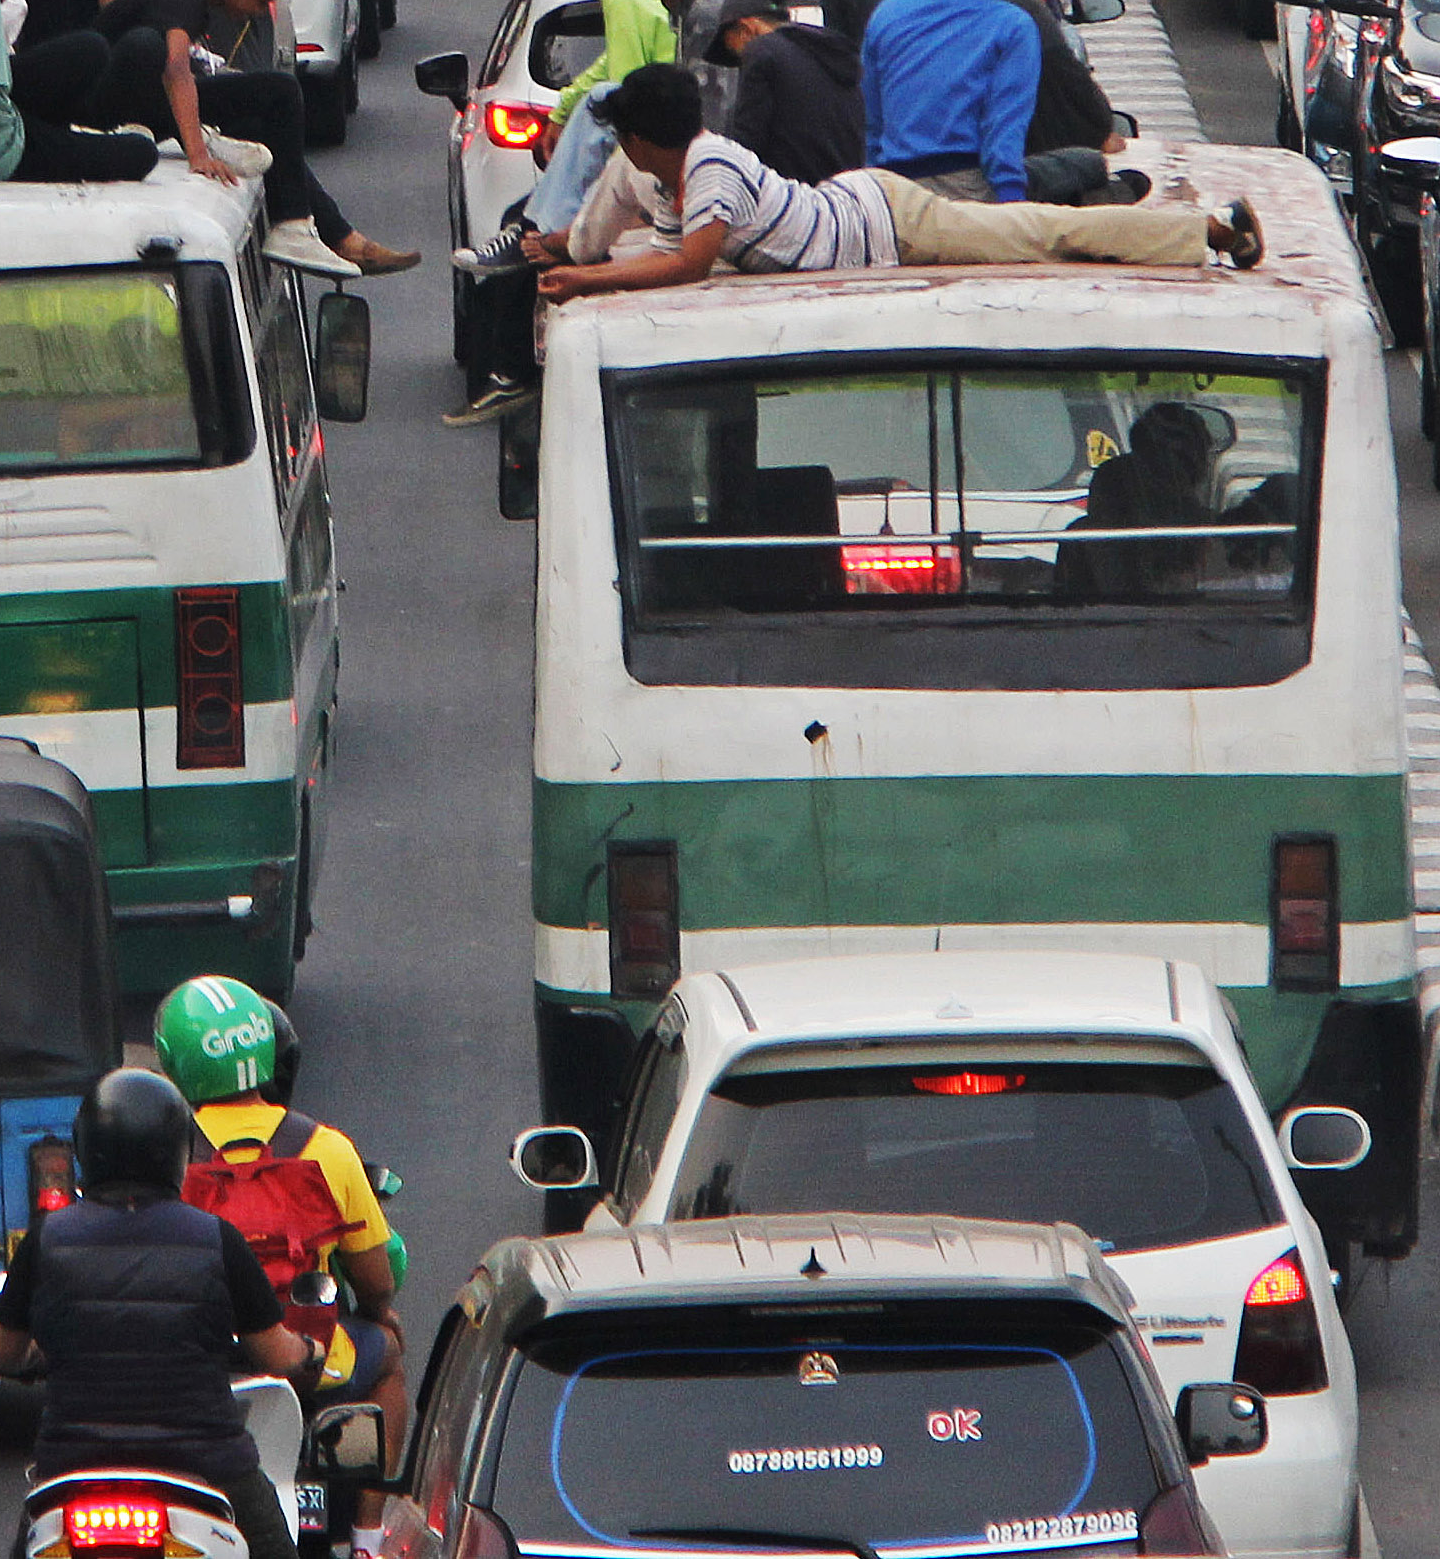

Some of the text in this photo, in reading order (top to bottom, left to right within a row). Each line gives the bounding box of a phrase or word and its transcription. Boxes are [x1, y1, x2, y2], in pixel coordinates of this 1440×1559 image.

[202, 1011, 271, 1059] Grab
[927, 1407, 982, 1442] OK
[728, 1445, 884, 1472] 087881561999
[987, 1511, 1138, 1543] 082122879096
